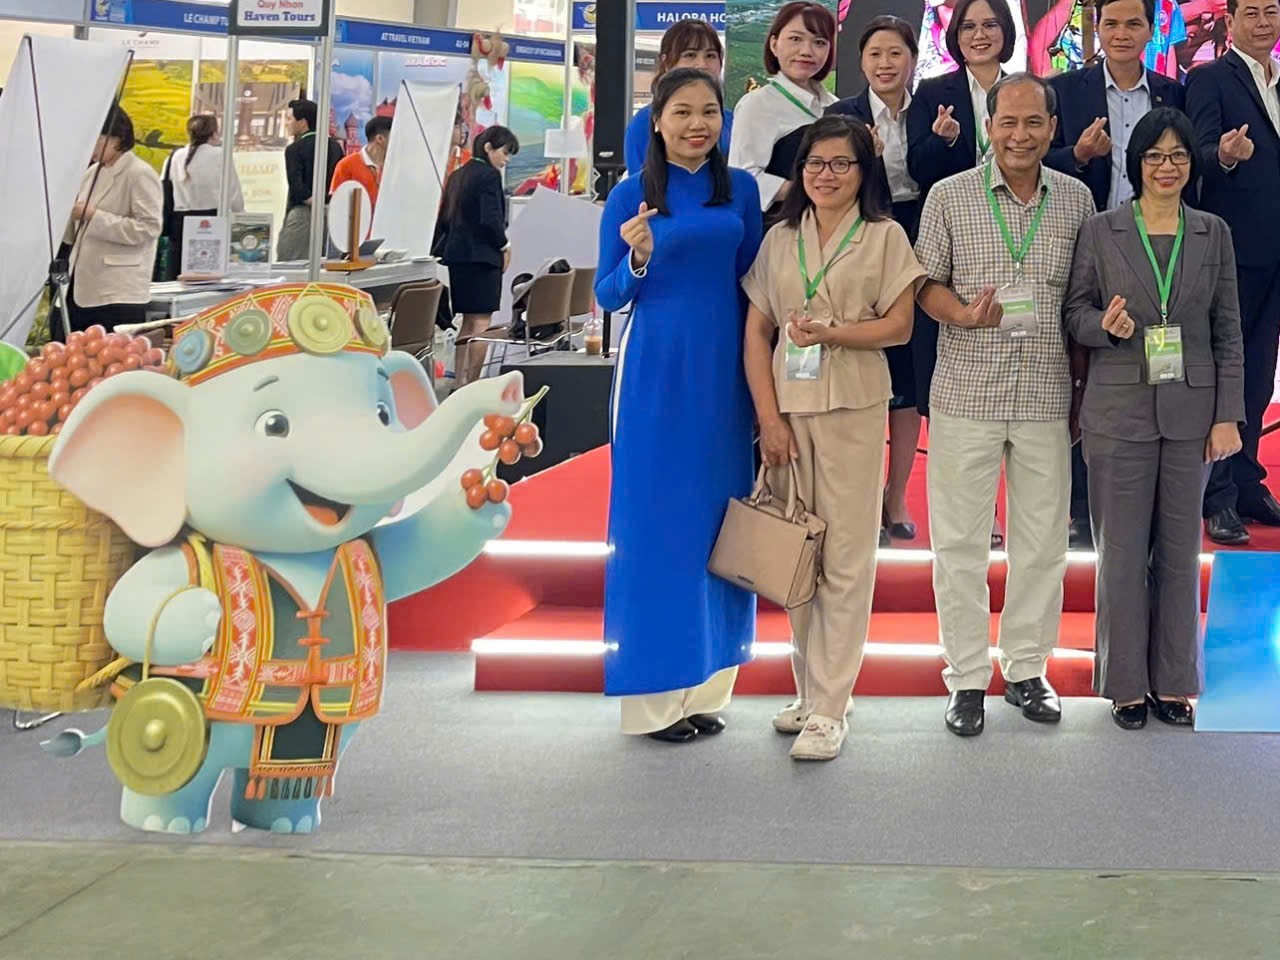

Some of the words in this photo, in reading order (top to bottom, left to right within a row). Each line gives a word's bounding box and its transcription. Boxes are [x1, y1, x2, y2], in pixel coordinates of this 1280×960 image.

[257, 0, 276, 10] Quy
[244, 11, 279, 22] Haven
[282, 12, 316, 22] Tours
